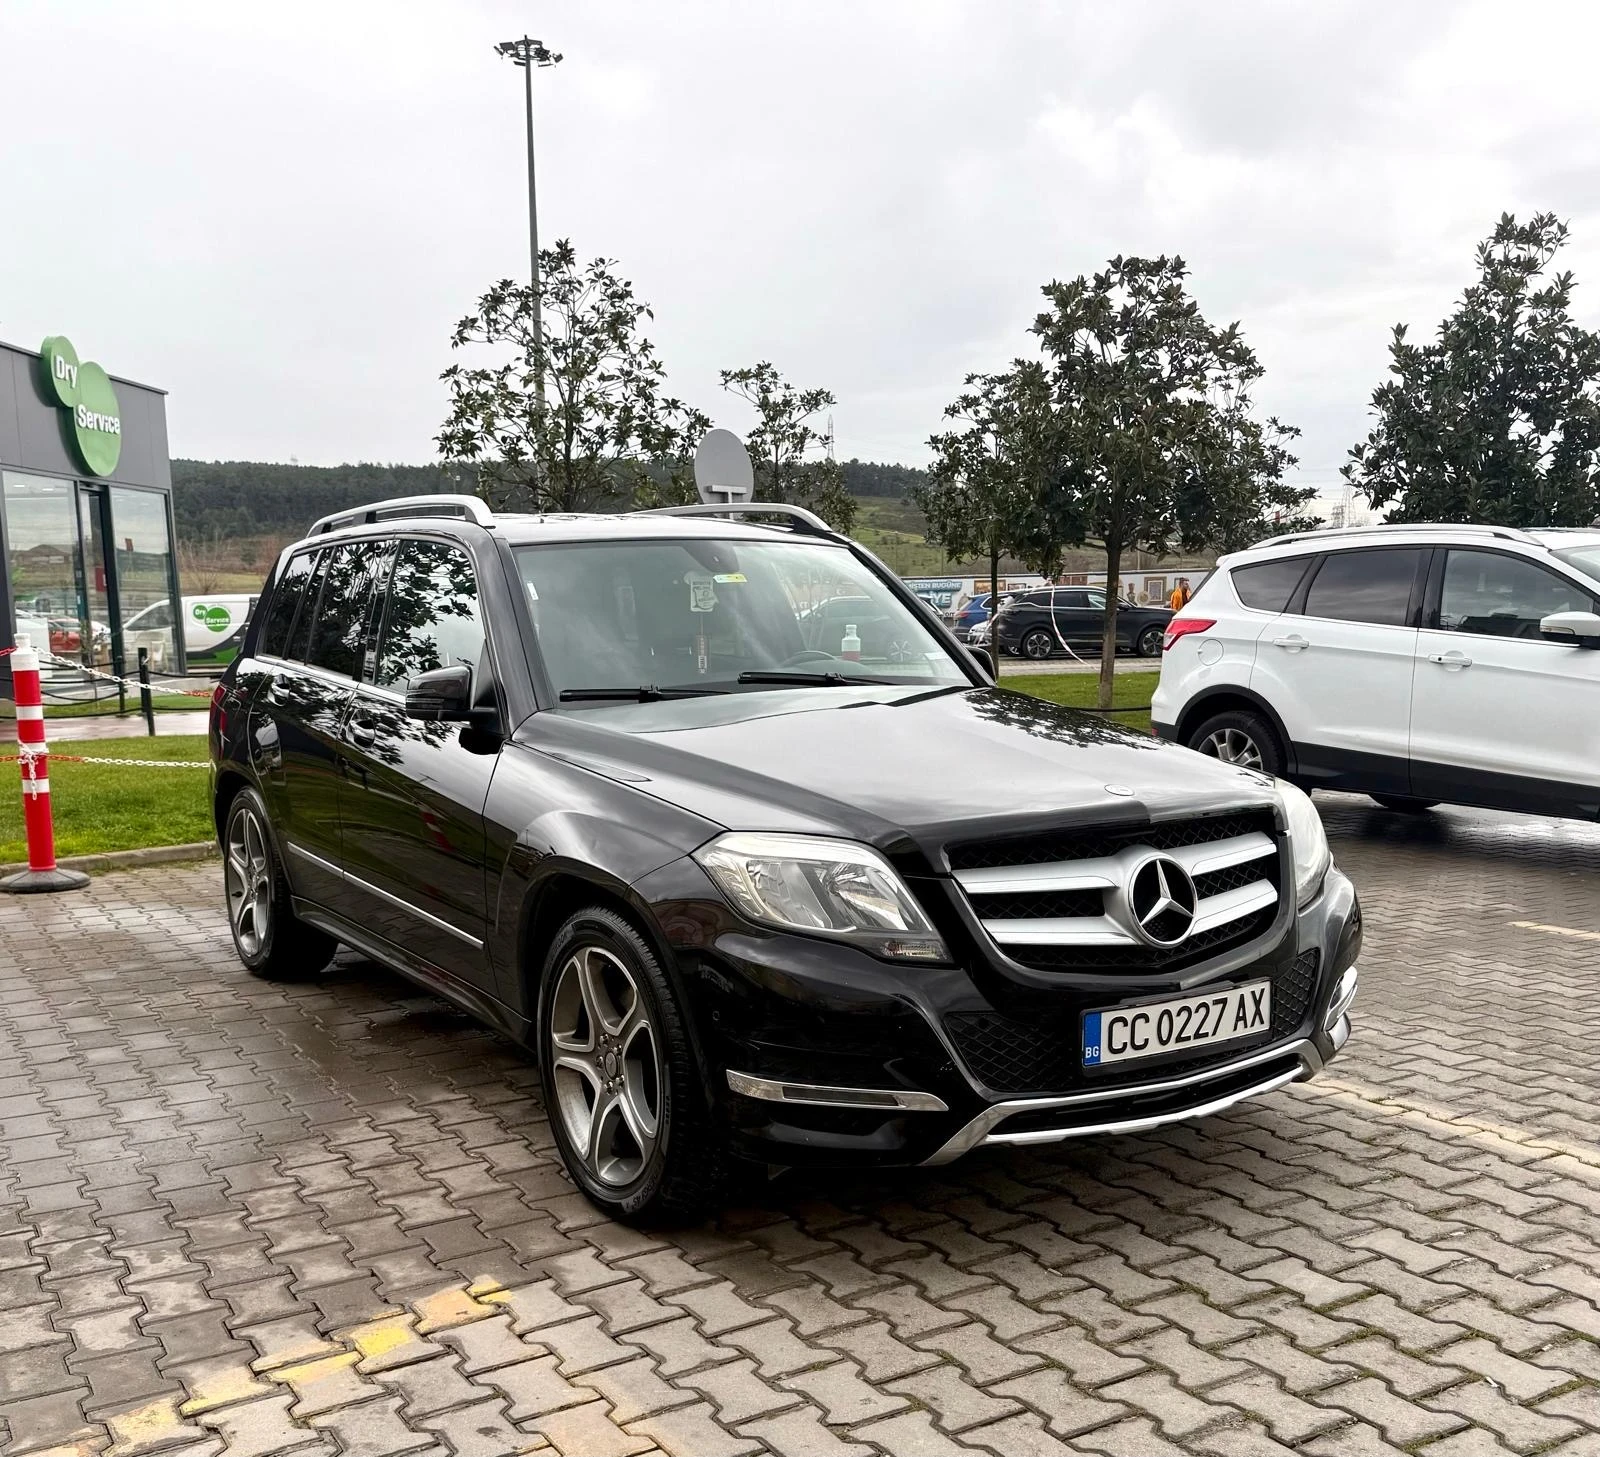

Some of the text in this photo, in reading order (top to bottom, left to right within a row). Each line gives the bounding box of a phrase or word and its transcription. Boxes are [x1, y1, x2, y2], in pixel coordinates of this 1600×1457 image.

[56, 355, 77, 389] Dry
[77, 403, 120, 434] Service
[1107, 987, 1265, 1054] CC 0227 AX
[1085, 1045, 1099, 1058] BG
